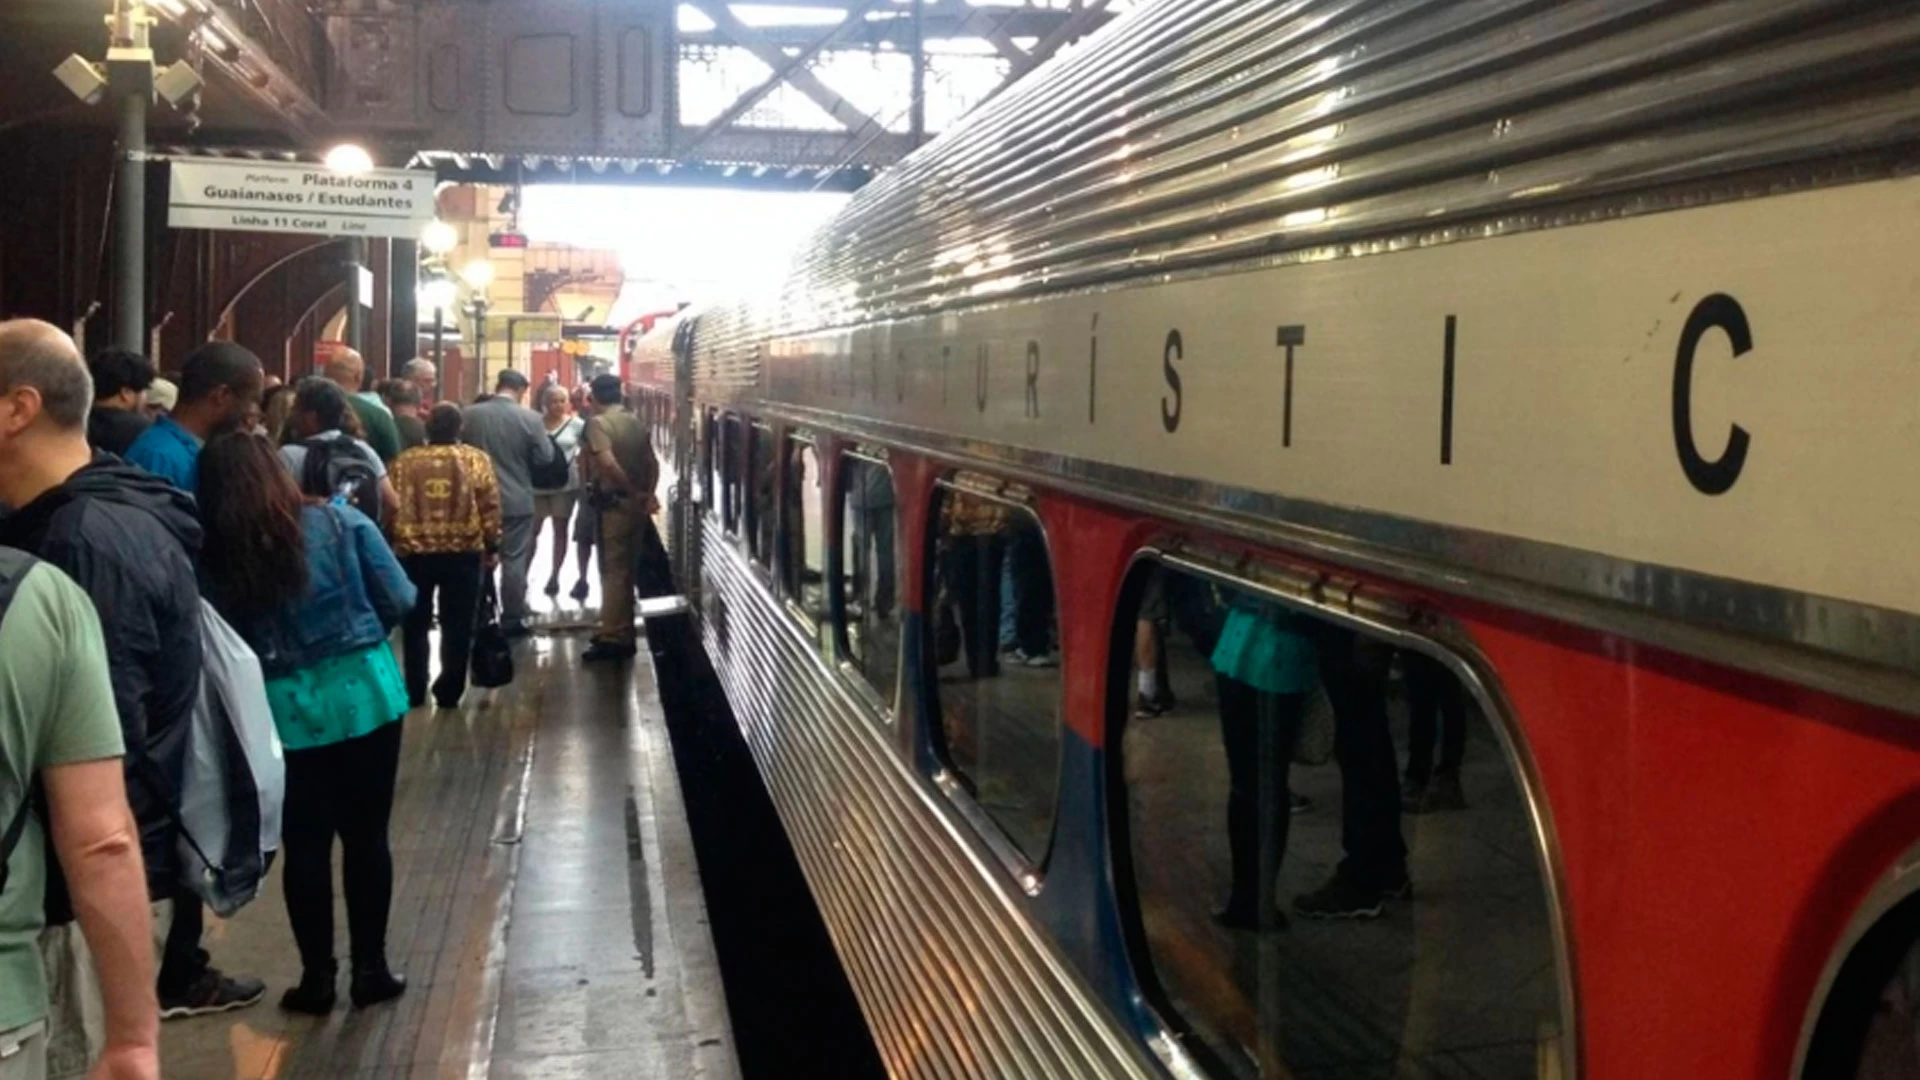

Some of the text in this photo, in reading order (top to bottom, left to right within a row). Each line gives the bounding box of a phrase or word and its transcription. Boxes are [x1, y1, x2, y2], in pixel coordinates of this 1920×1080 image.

[302, 173, 398, 190] Plataforma
[402, 179, 414, 191] 4
[203, 186, 413, 209] Guaianases / Estudantes
[232, 215, 366, 231] Linha 11 Coral Line
